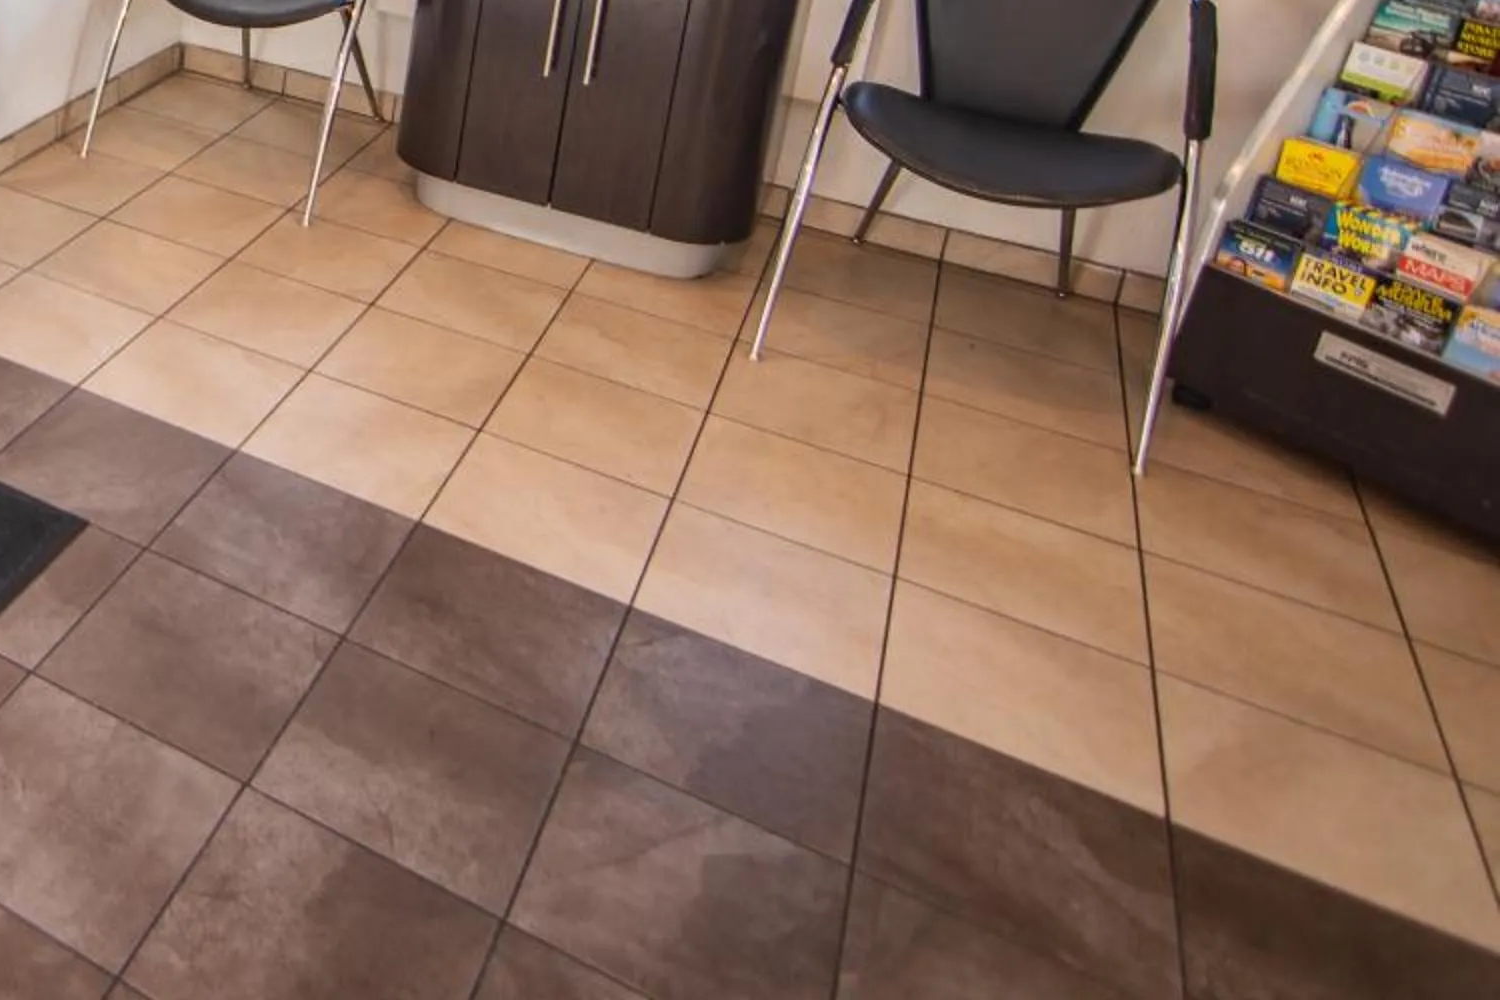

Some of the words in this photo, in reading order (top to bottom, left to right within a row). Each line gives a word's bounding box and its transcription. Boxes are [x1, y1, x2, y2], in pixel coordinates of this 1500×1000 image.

[1300, 270, 1348, 296] INFO
[1302, 258, 1367, 292] TRAVEL
[1405, 258, 1466, 294] MAPS
